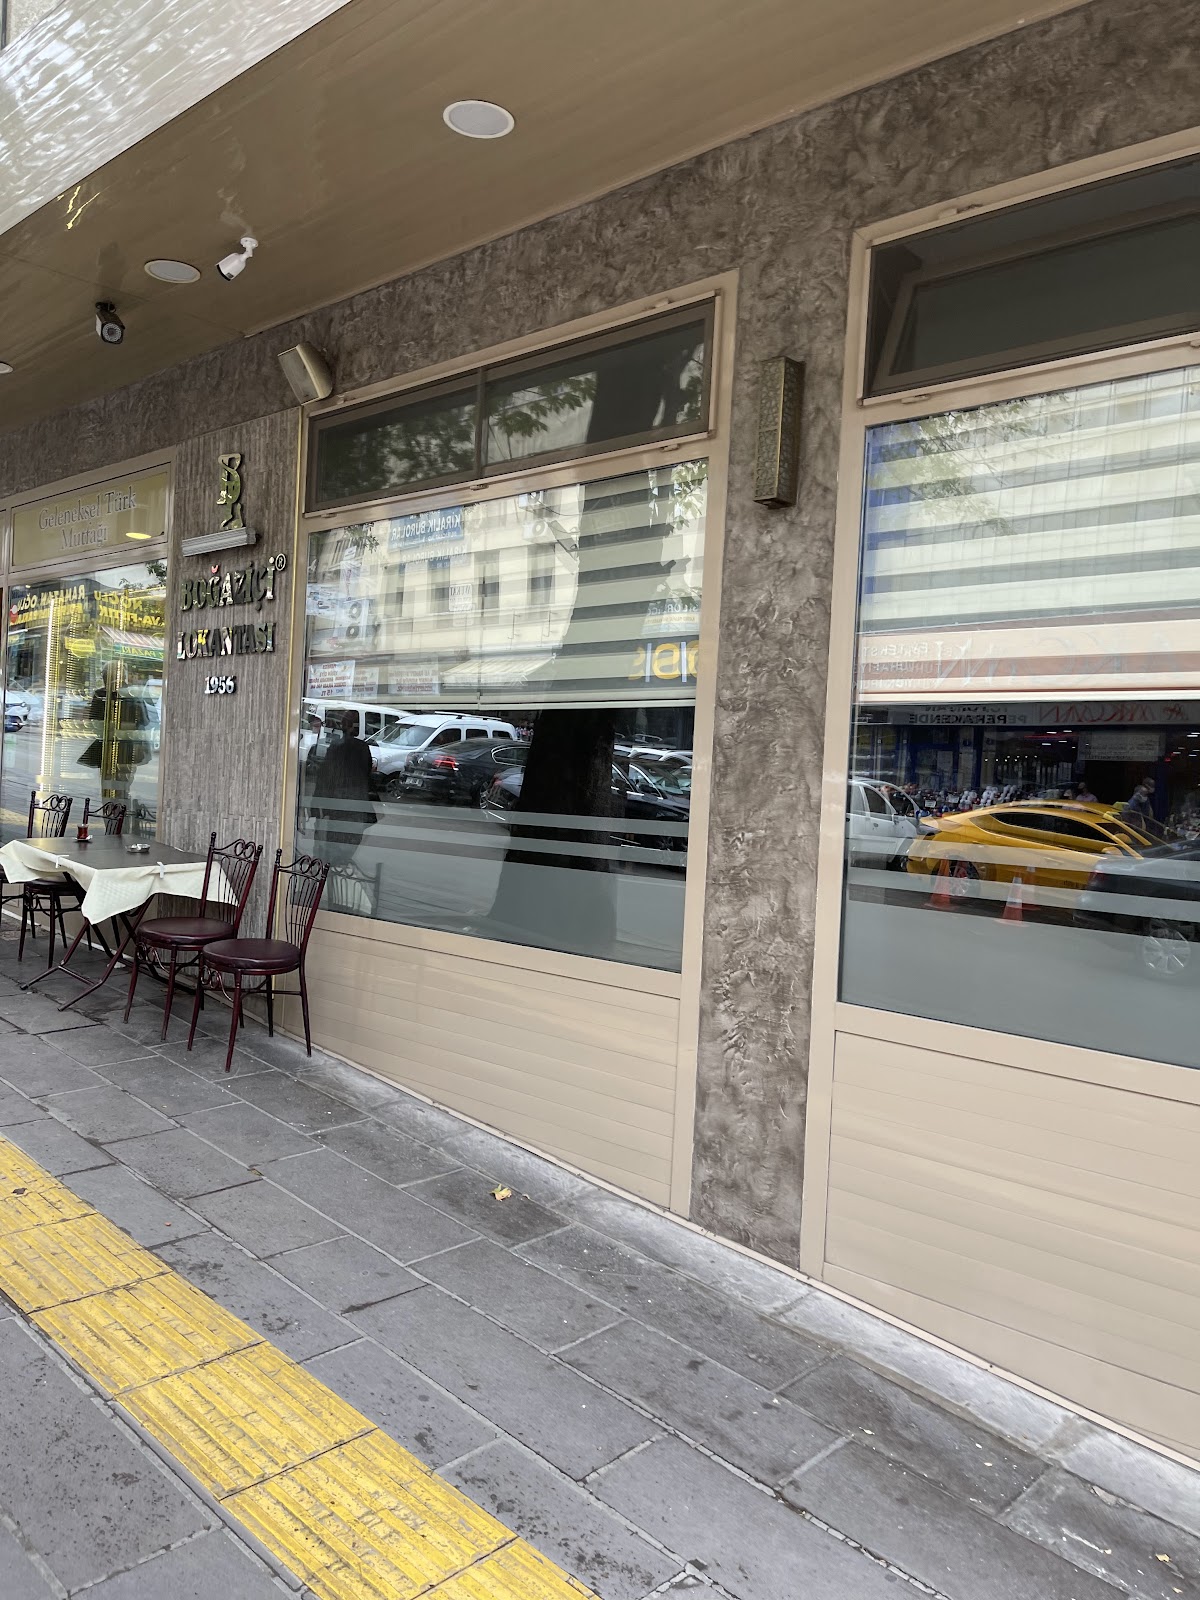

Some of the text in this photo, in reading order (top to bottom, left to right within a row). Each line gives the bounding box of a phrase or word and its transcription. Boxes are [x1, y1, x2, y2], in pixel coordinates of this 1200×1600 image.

[38, 486, 136, 530] Geleneksel Türk
[61, 523, 108, 549] Mutfağı
[177, 622, 276, 660] LOKANTASI
[204, 676, 236, 694] 1956
